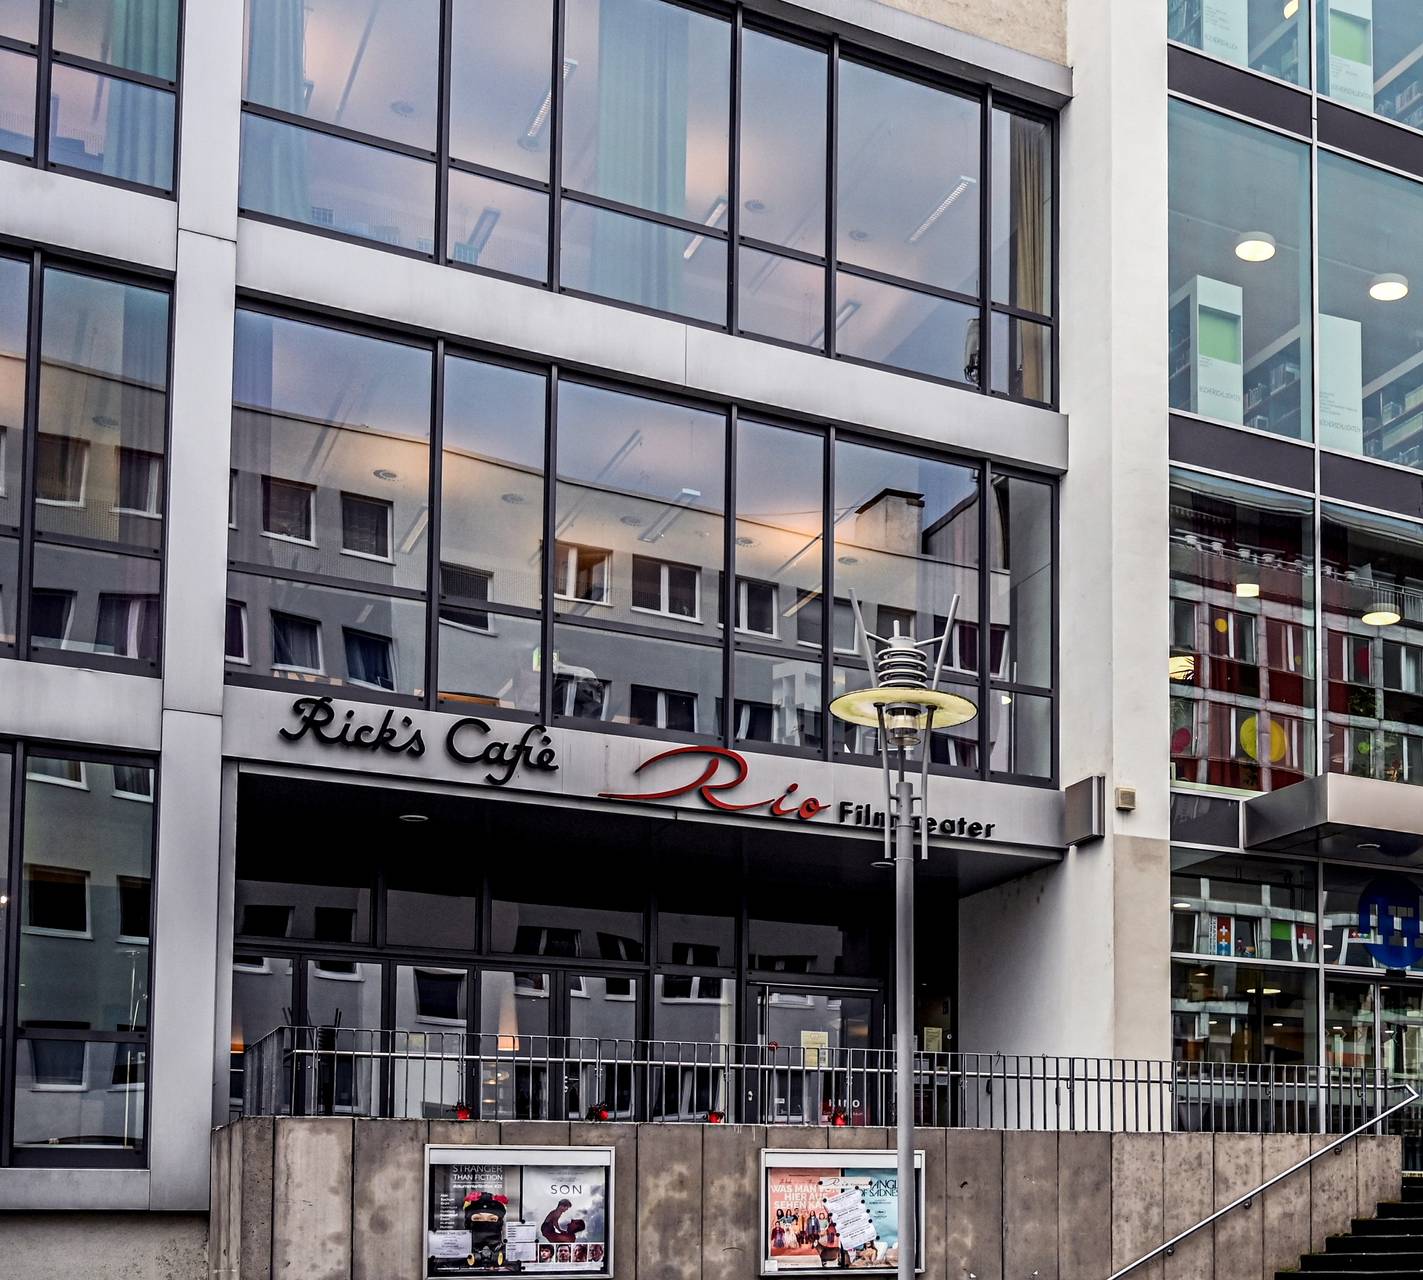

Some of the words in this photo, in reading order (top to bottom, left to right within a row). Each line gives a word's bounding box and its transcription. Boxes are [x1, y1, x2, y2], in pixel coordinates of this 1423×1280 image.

[279, 697, 426, 757] Rick's
[447, 717, 559, 785] Café
[597, 745, 831, 820] Rio
[452, 1164, 503, 1173] STRANGER
[550, 1184, 582, 1195] SON
[770, 1184, 793, 1193] WAS
[794, 1184, 817, 1193] MAN
[784, 1192, 808, 1201] HIER
[774, 1200, 806, 1209] SEHEN
